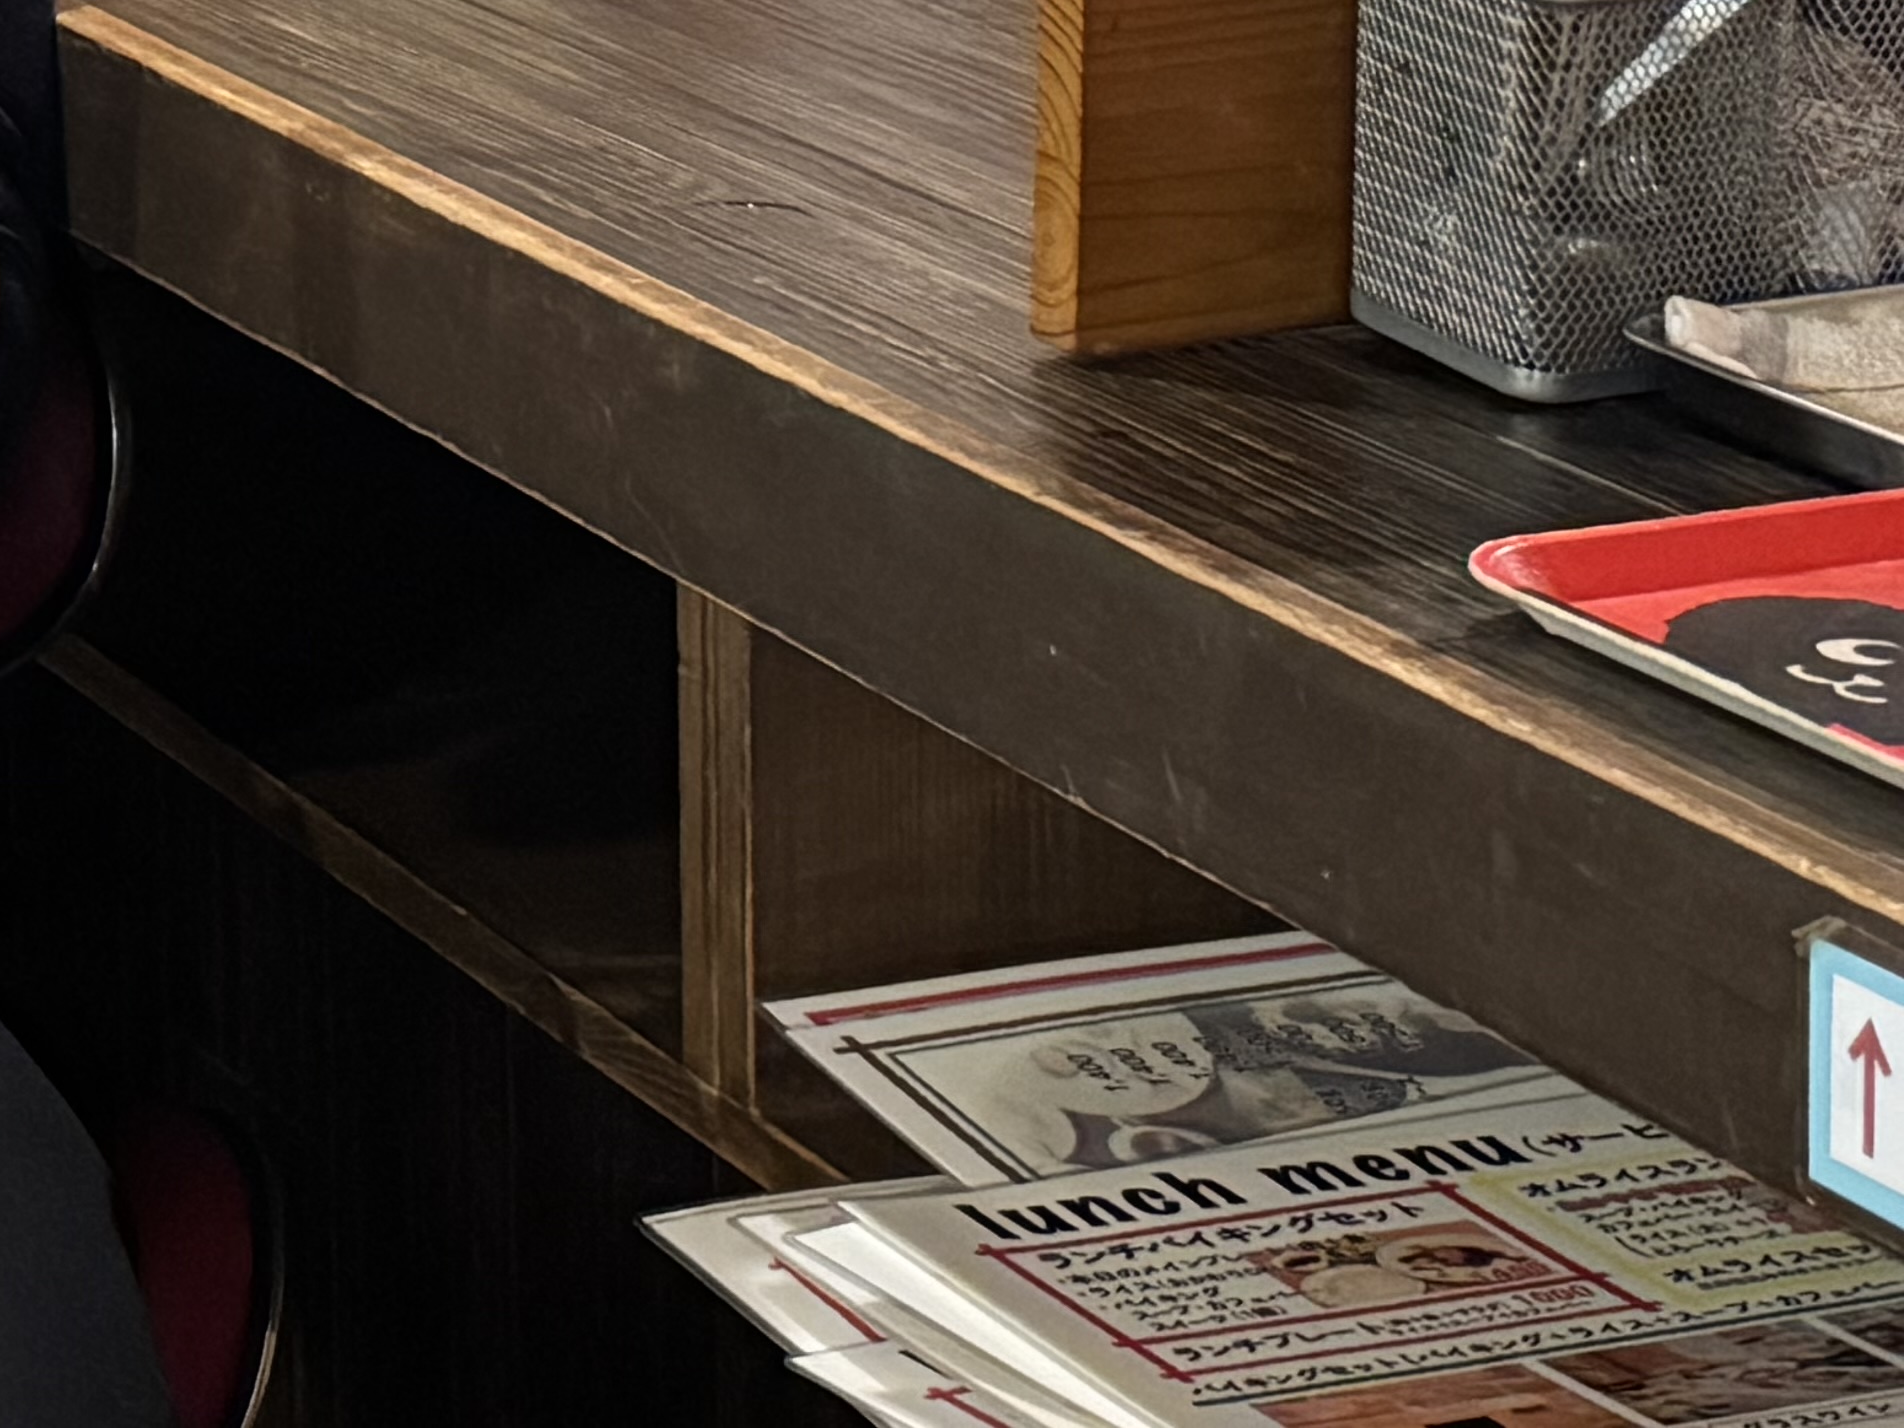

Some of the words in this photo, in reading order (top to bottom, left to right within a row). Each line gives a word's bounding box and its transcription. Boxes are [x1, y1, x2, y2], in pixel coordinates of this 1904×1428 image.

[952, 1170, 1248, 1241] lunch
[1257, 1133, 1533, 1196] menu
[1038, 1200, 1425, 1269] ランチバイキングセット
